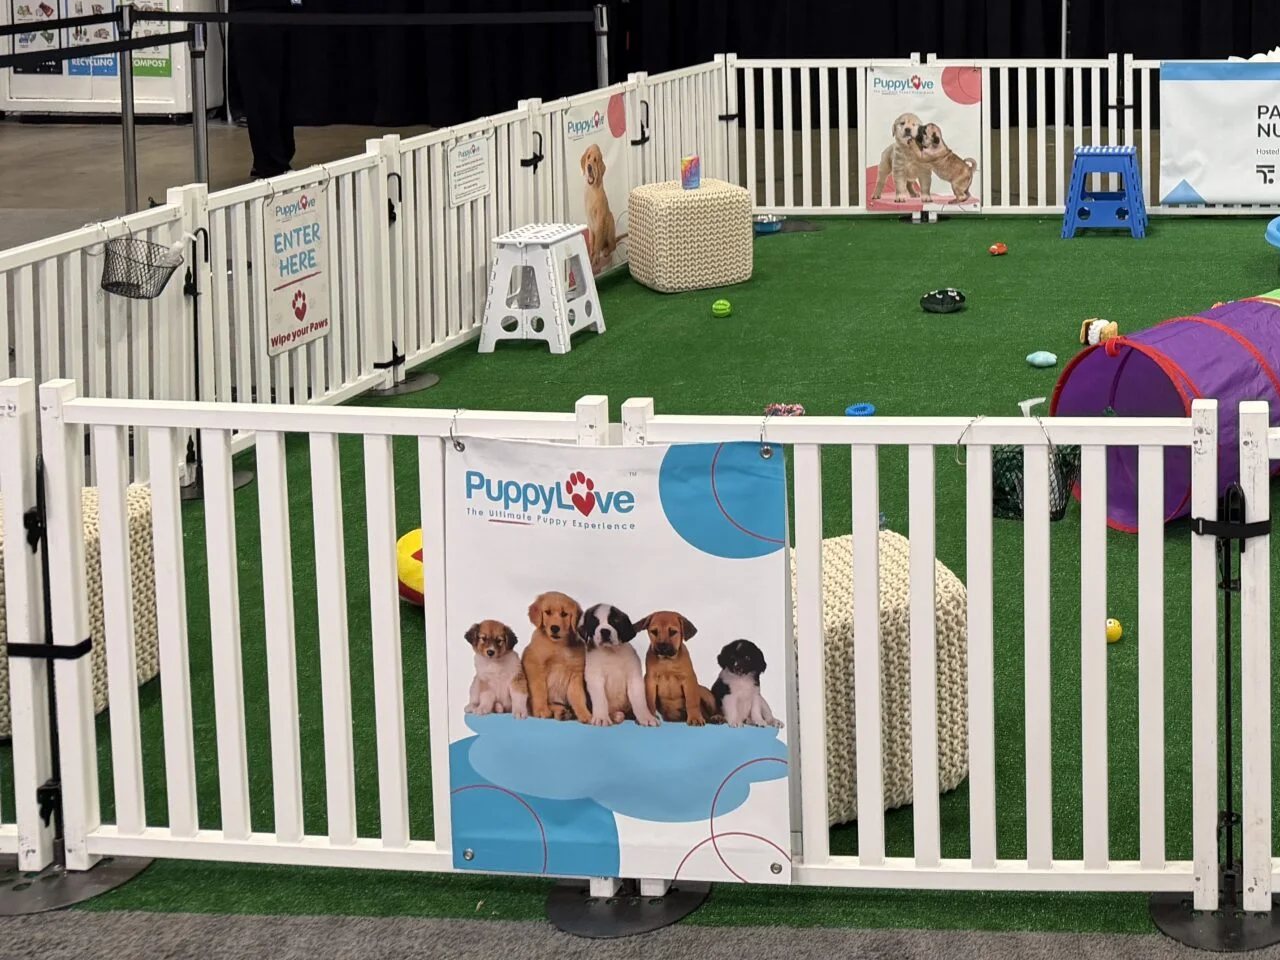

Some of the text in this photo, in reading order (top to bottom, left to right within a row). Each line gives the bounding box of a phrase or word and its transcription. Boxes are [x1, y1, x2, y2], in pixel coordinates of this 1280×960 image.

[71, 58, 113, 67] RECYCLING
[133, 59, 166, 68] OMPOST
[874, 74, 934, 91] PuppyLove
[567, 110, 605, 134] PuppyLove
[275, 194, 316, 217] PuppyLove
[274, 222, 321, 254] ENTER
[279, 248, 317, 278] HERE
[271, 317, 328, 348] Wipe your Paws
[465, 470, 635, 517] PuppyLove
[466, 508, 636, 530] The Ultimate Puppy Experience
